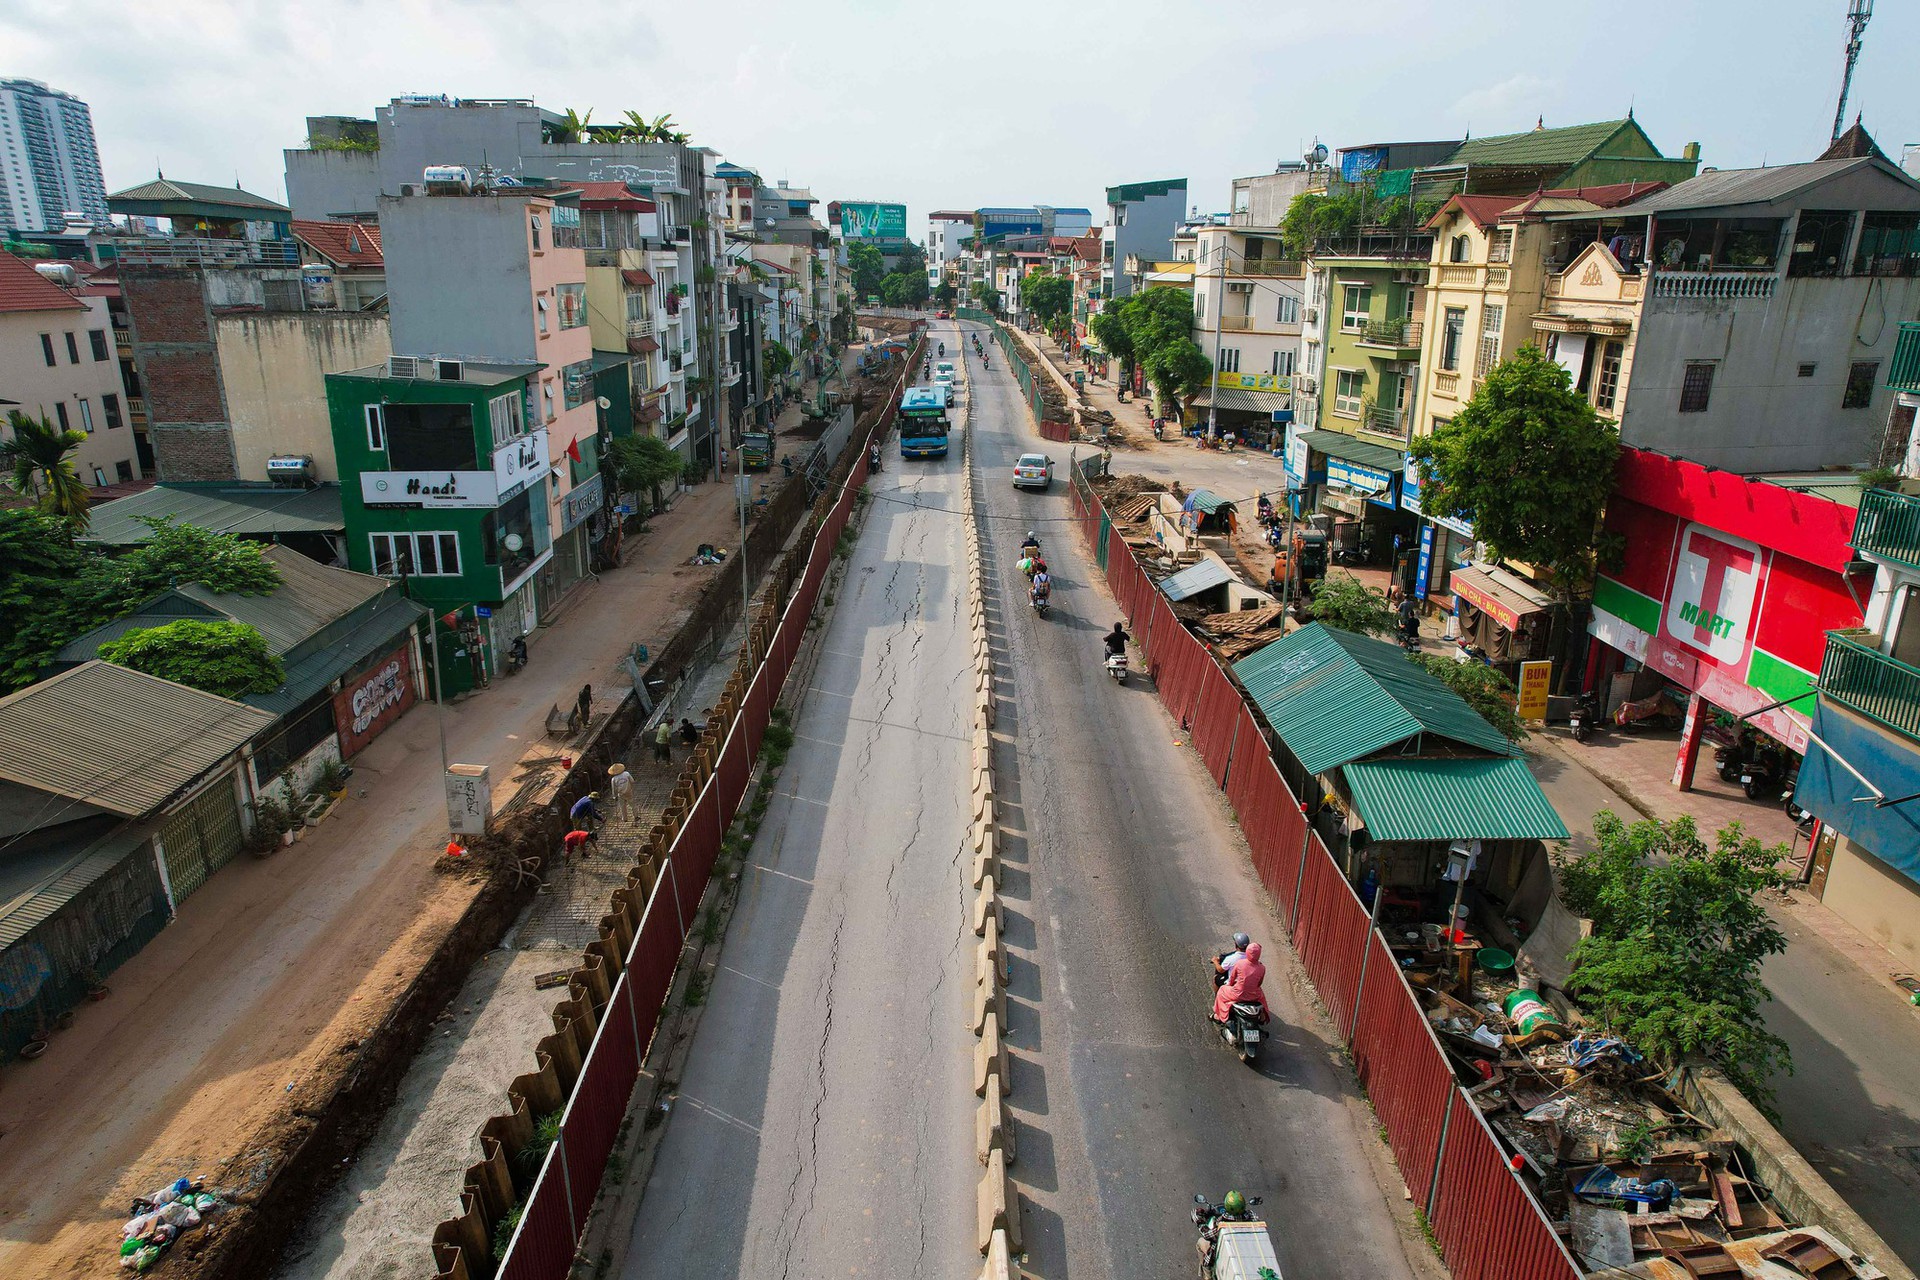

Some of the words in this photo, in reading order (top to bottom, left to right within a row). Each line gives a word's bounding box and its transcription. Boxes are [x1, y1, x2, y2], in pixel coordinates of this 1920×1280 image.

[407, 473, 455, 495] Handi
[1688, 531, 1755, 647] T
[1486, 601, 1497, 614] BIA
[1679, 601, 1735, 639] MART
